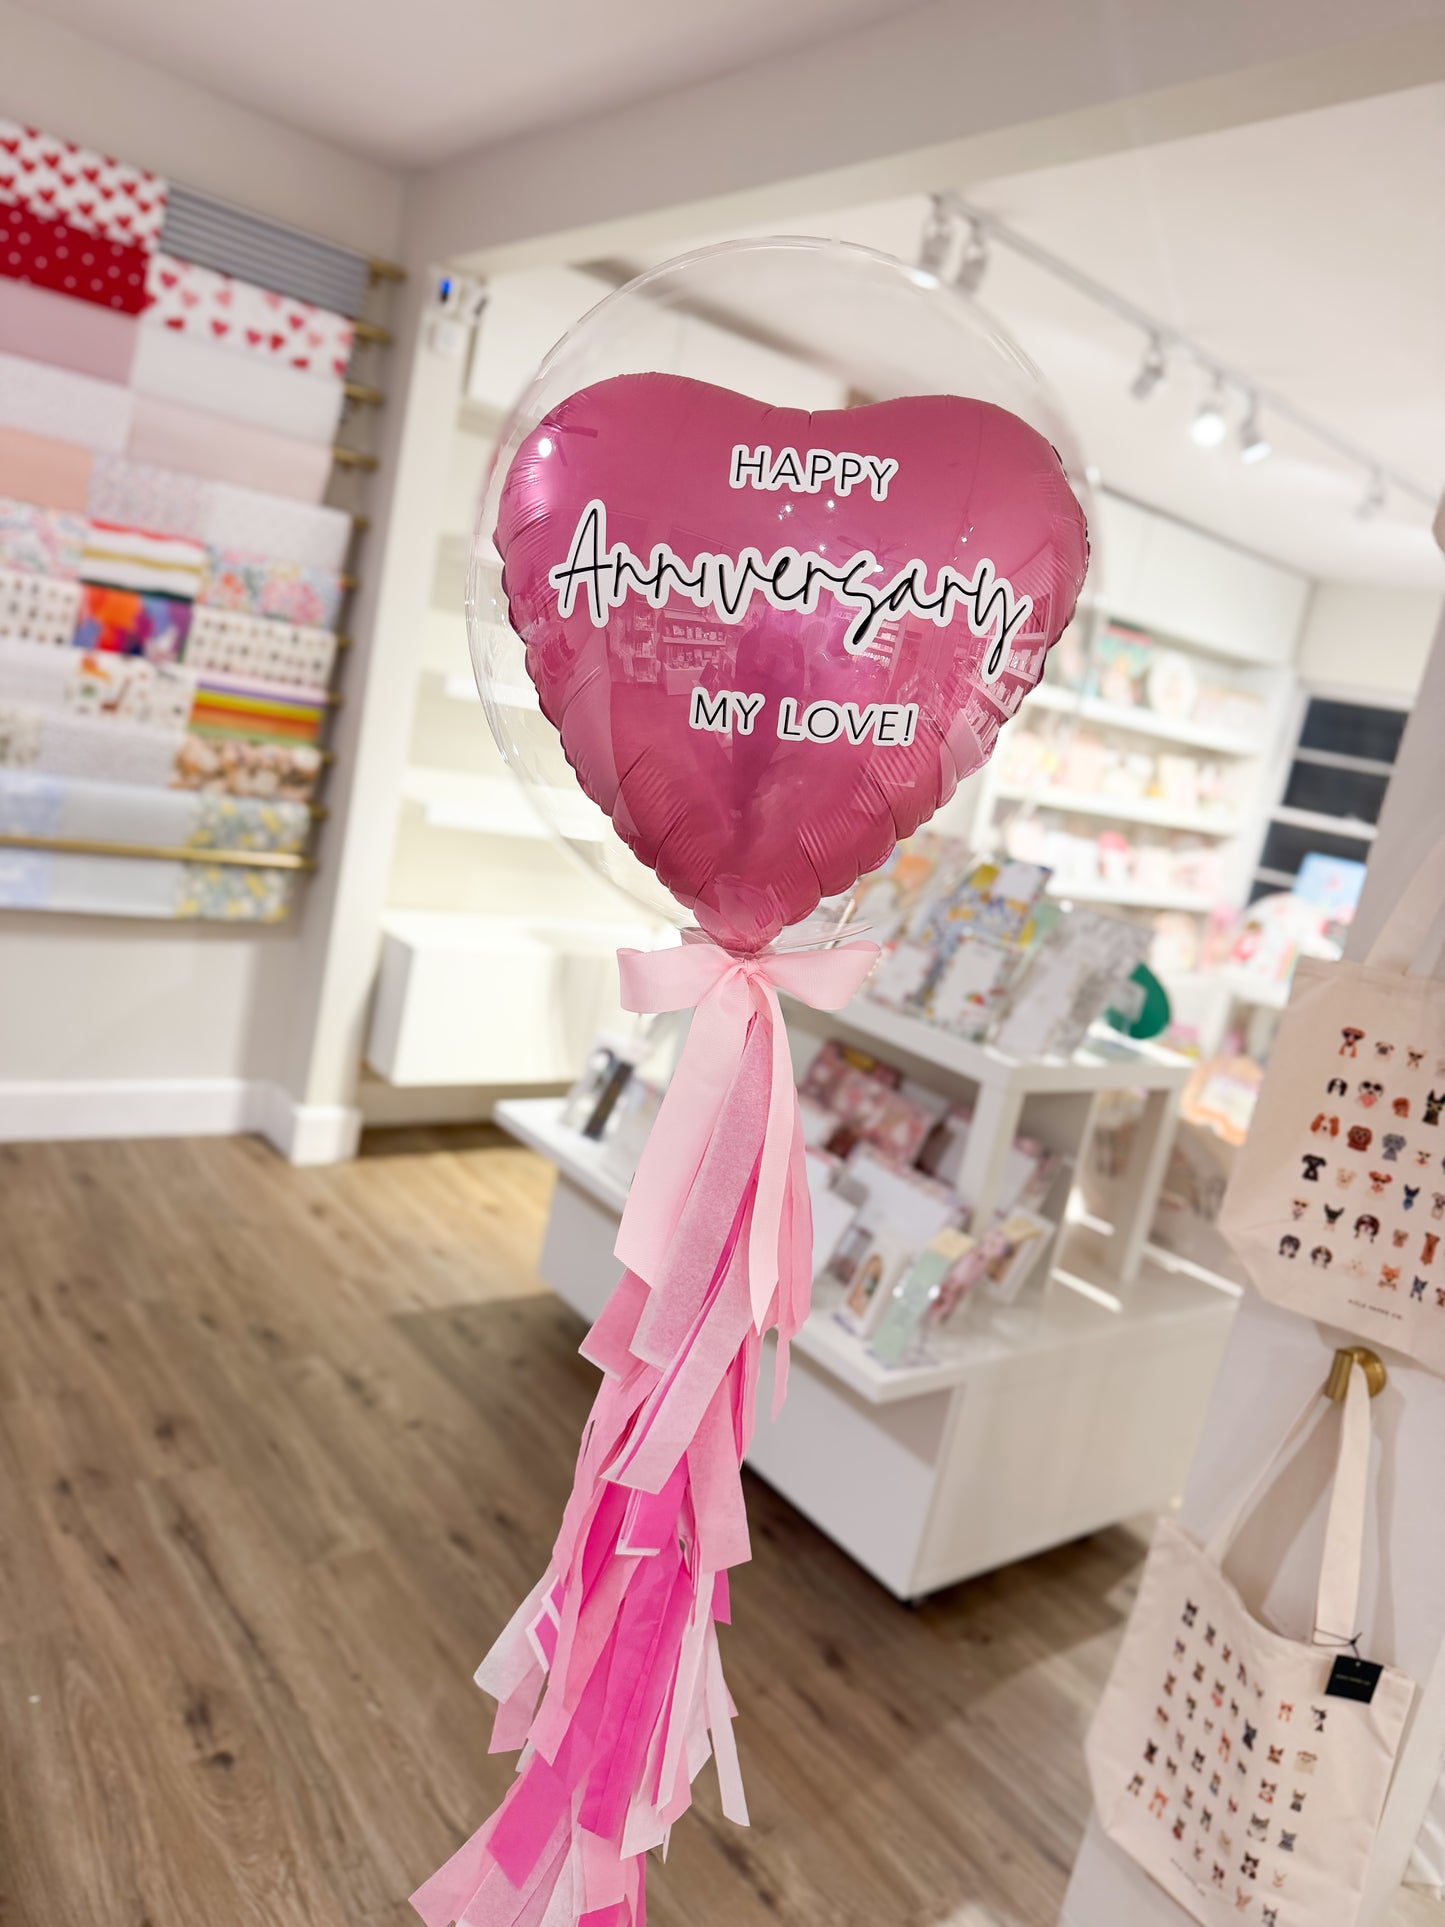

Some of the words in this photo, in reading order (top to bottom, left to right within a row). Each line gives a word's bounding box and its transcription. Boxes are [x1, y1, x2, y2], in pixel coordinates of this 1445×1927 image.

[735, 449, 893, 496] HAPPY
[553, 507, 1028, 676] Anniversary
[694, 692, 760, 731] MY
[782, 703, 914, 742] LOVE!
